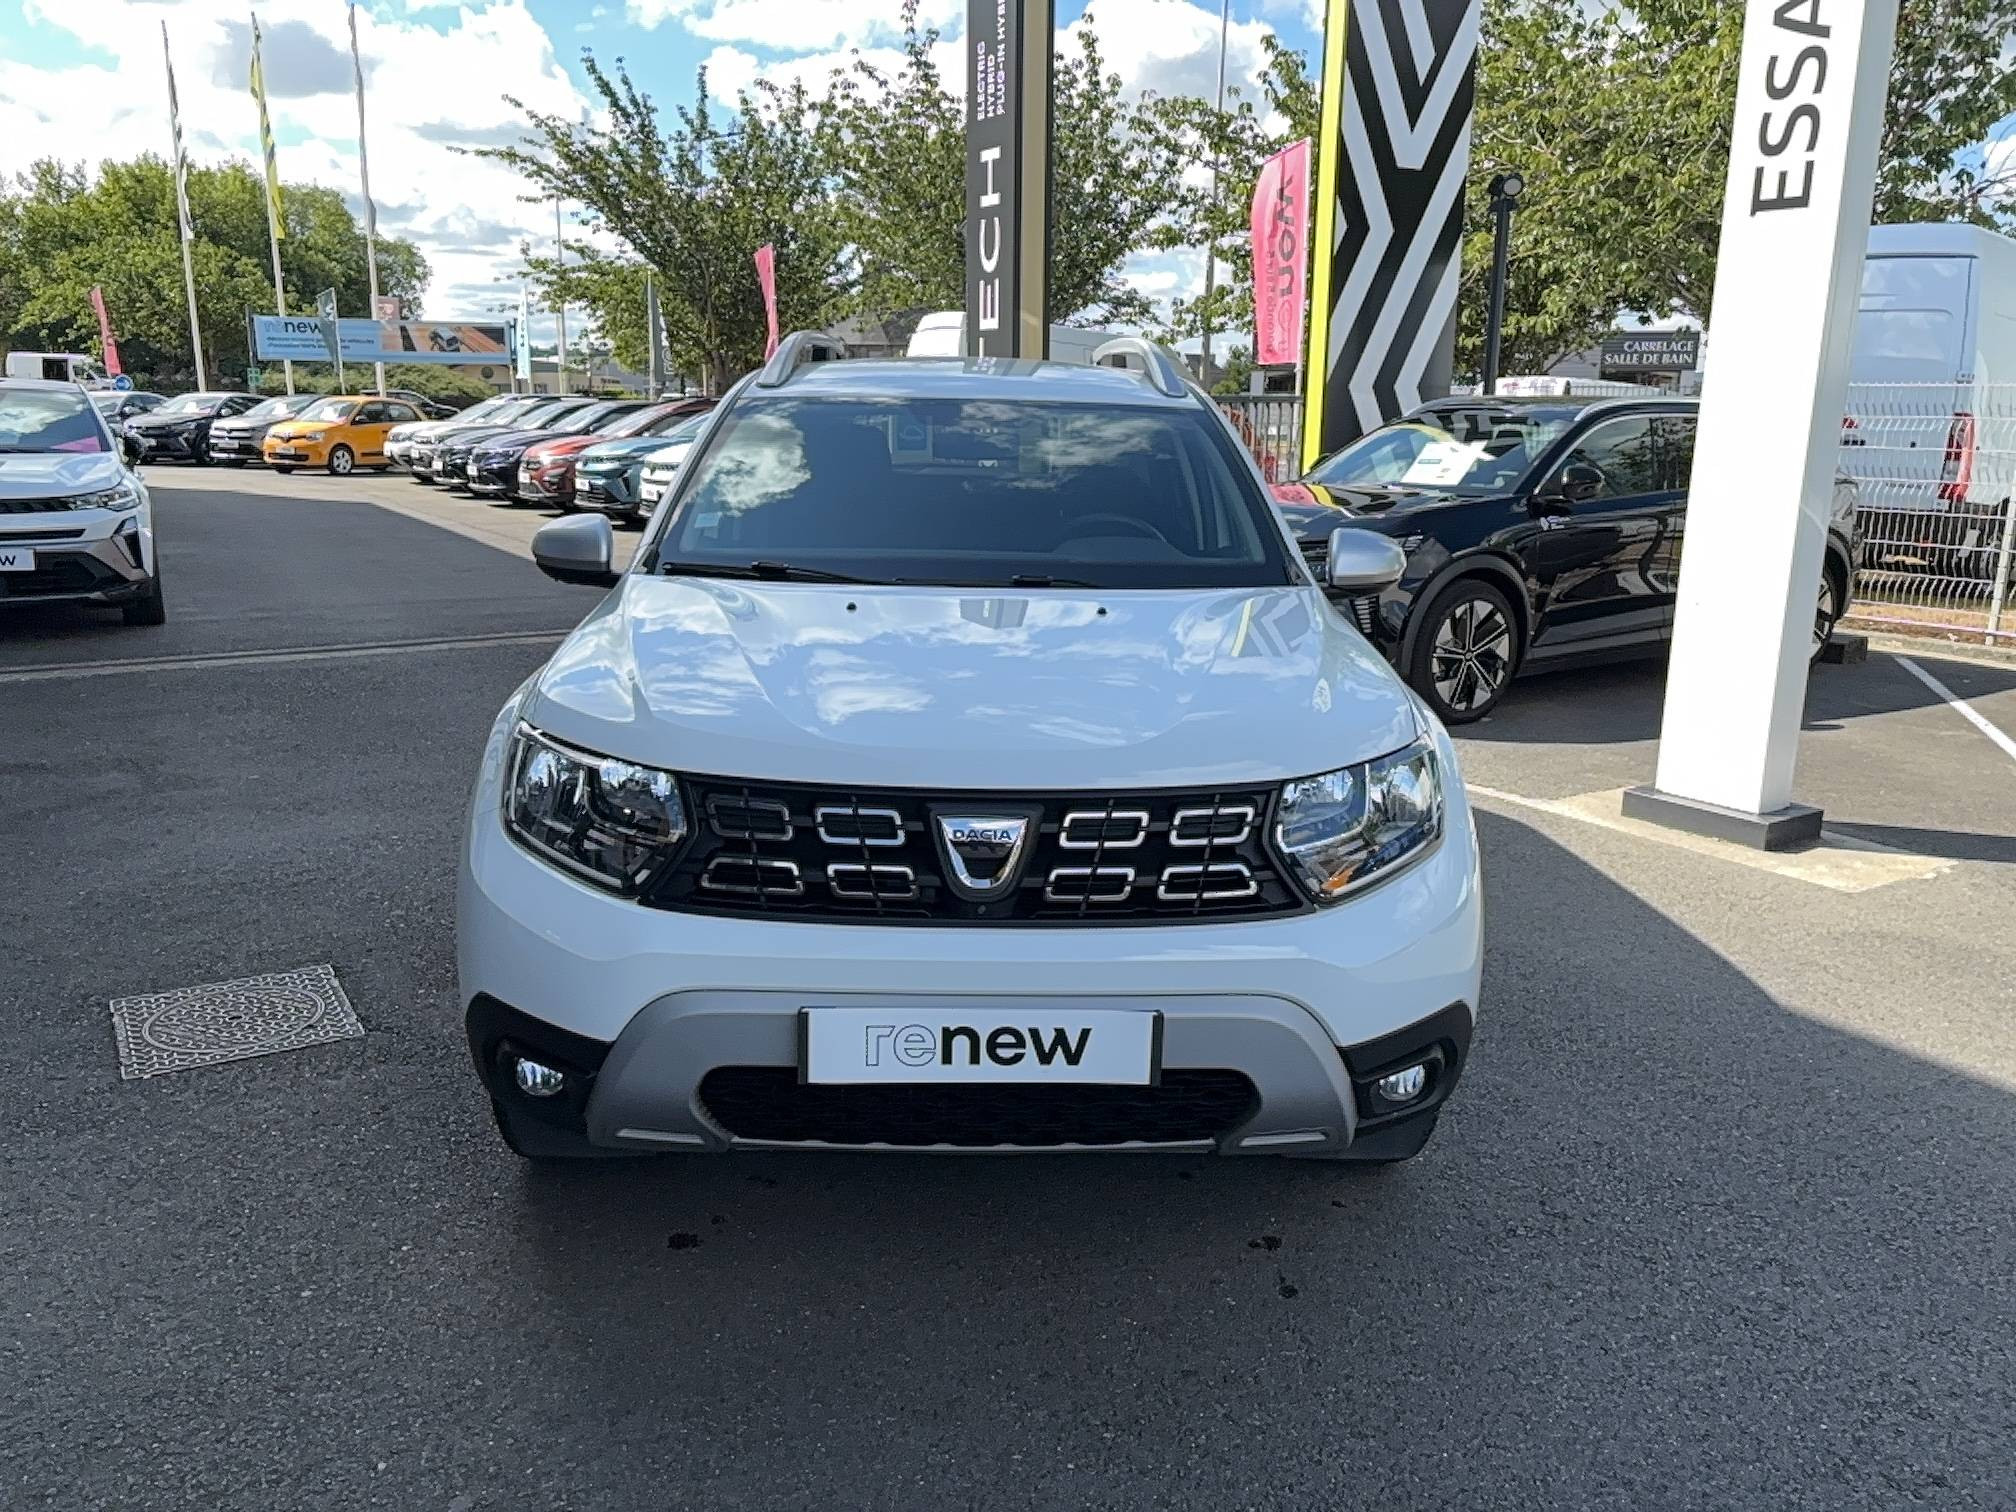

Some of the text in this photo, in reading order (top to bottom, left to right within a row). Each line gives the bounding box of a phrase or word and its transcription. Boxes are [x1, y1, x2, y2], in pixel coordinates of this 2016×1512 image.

[977, 41, 986, 122] ELECTRIC
[987, 54, 996, 118] HYBRID
[996, 43, 1006, 116] PLUG-IN
[1749, 0, 1832, 217] ESSA
[1604, 353, 1694, 365] SALLE DE BAIN
[1623, 341, 1694, 352] CARRELAGE
[953, 829, 1012, 841] DACIA
[864, 1023, 1092, 1068] renew
